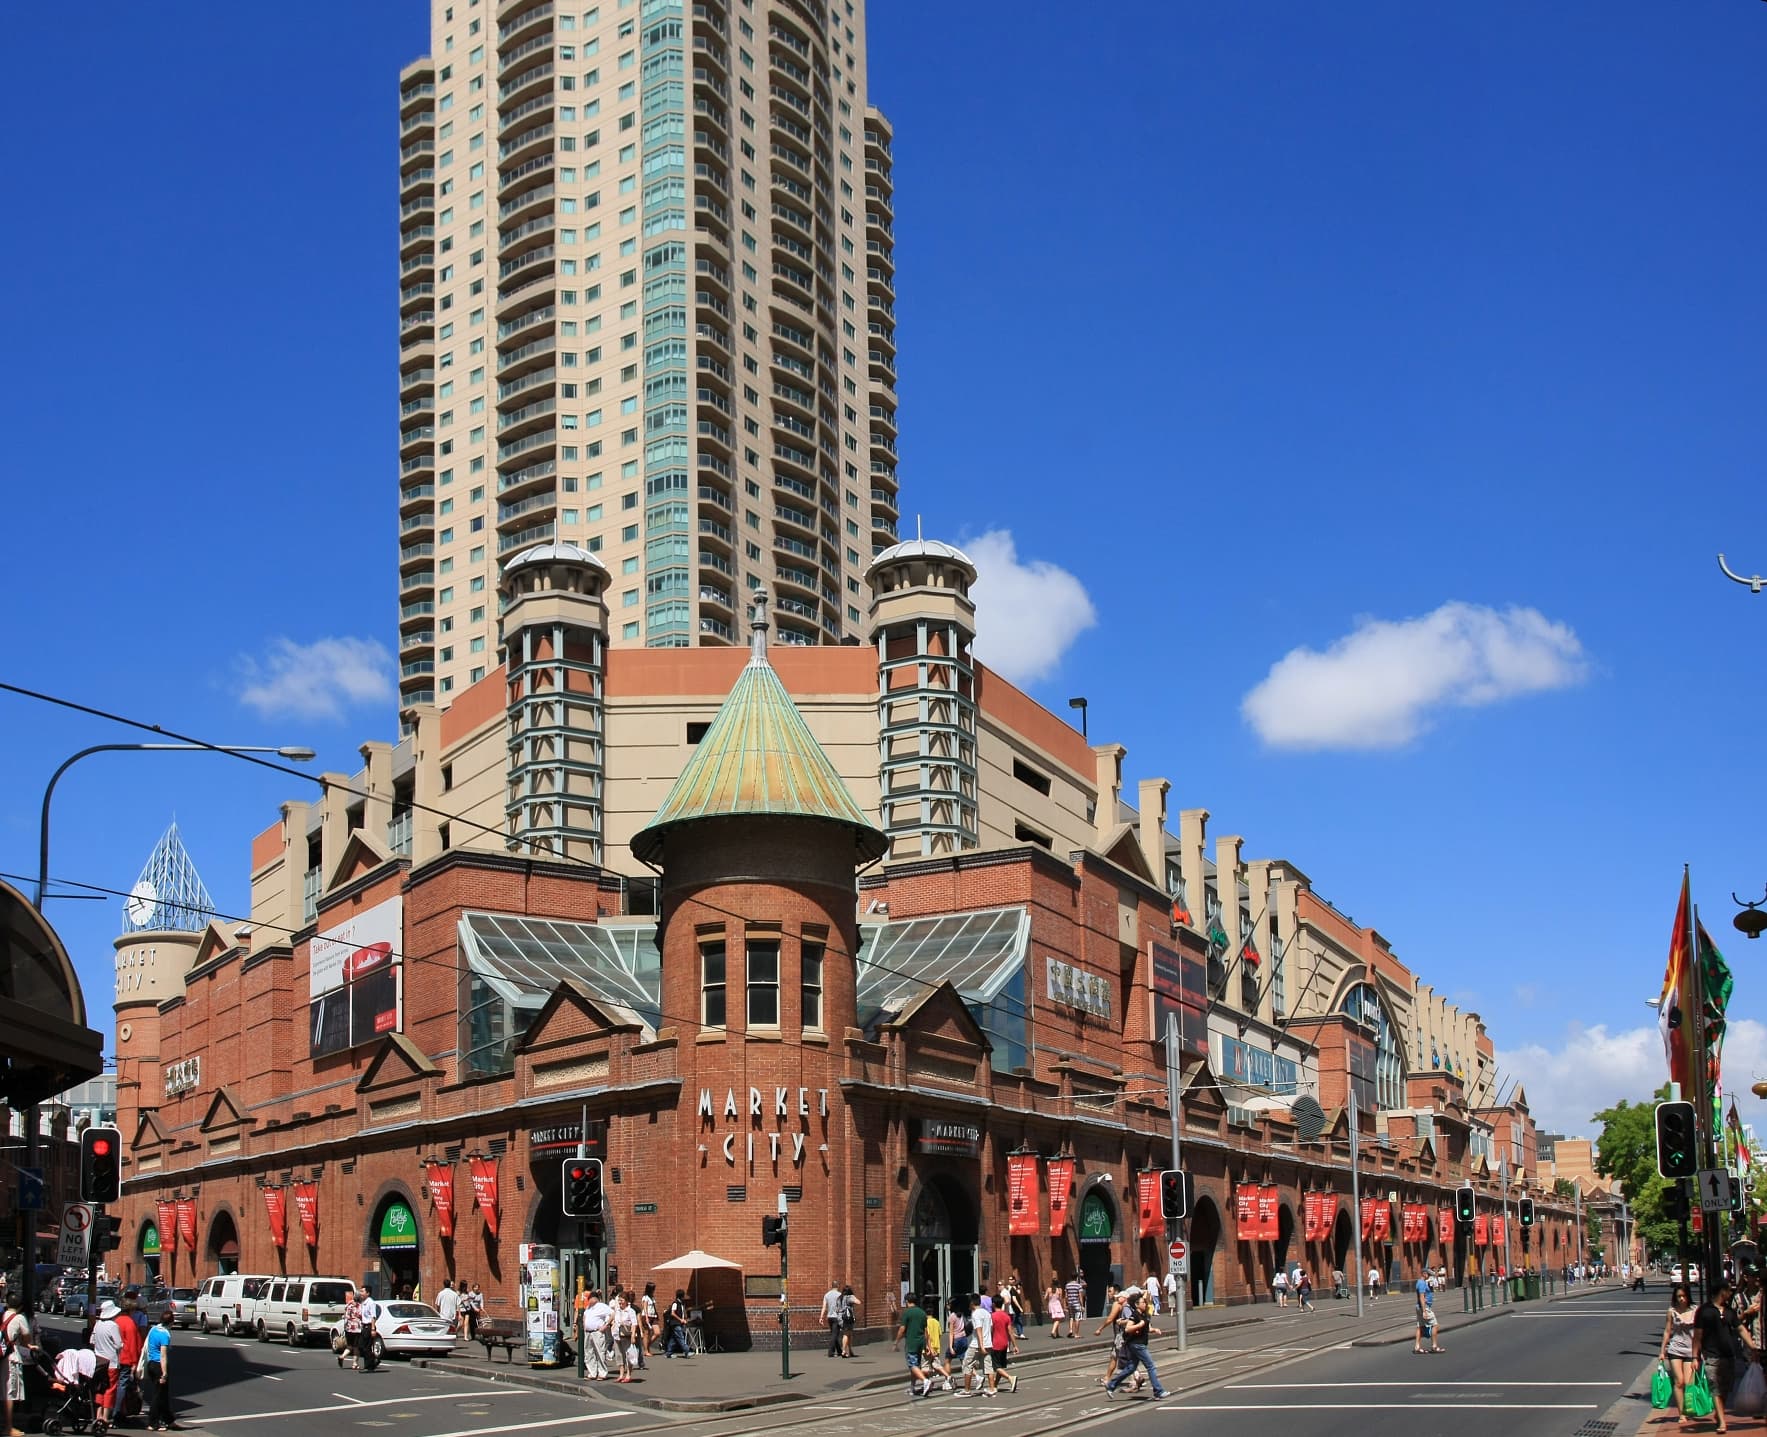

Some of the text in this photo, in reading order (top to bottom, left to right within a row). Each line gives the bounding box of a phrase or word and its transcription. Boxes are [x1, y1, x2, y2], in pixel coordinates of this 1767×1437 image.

[115, 948, 156, 970] RKET
[698, 1086, 829, 1117] MARKET
[936, 1125, 965, 1139] MARKET
[723, 1132, 804, 1161] CITY
[429, 1180, 449, 1188] Market
[472, 1175, 494, 1183] Market
[1704, 1198, 1728, 1208] ONLY
[66, 1233, 82, 1245] NO
[62, 1245, 83, 1253] LEFT
[60, 1254, 83, 1264] TURN
